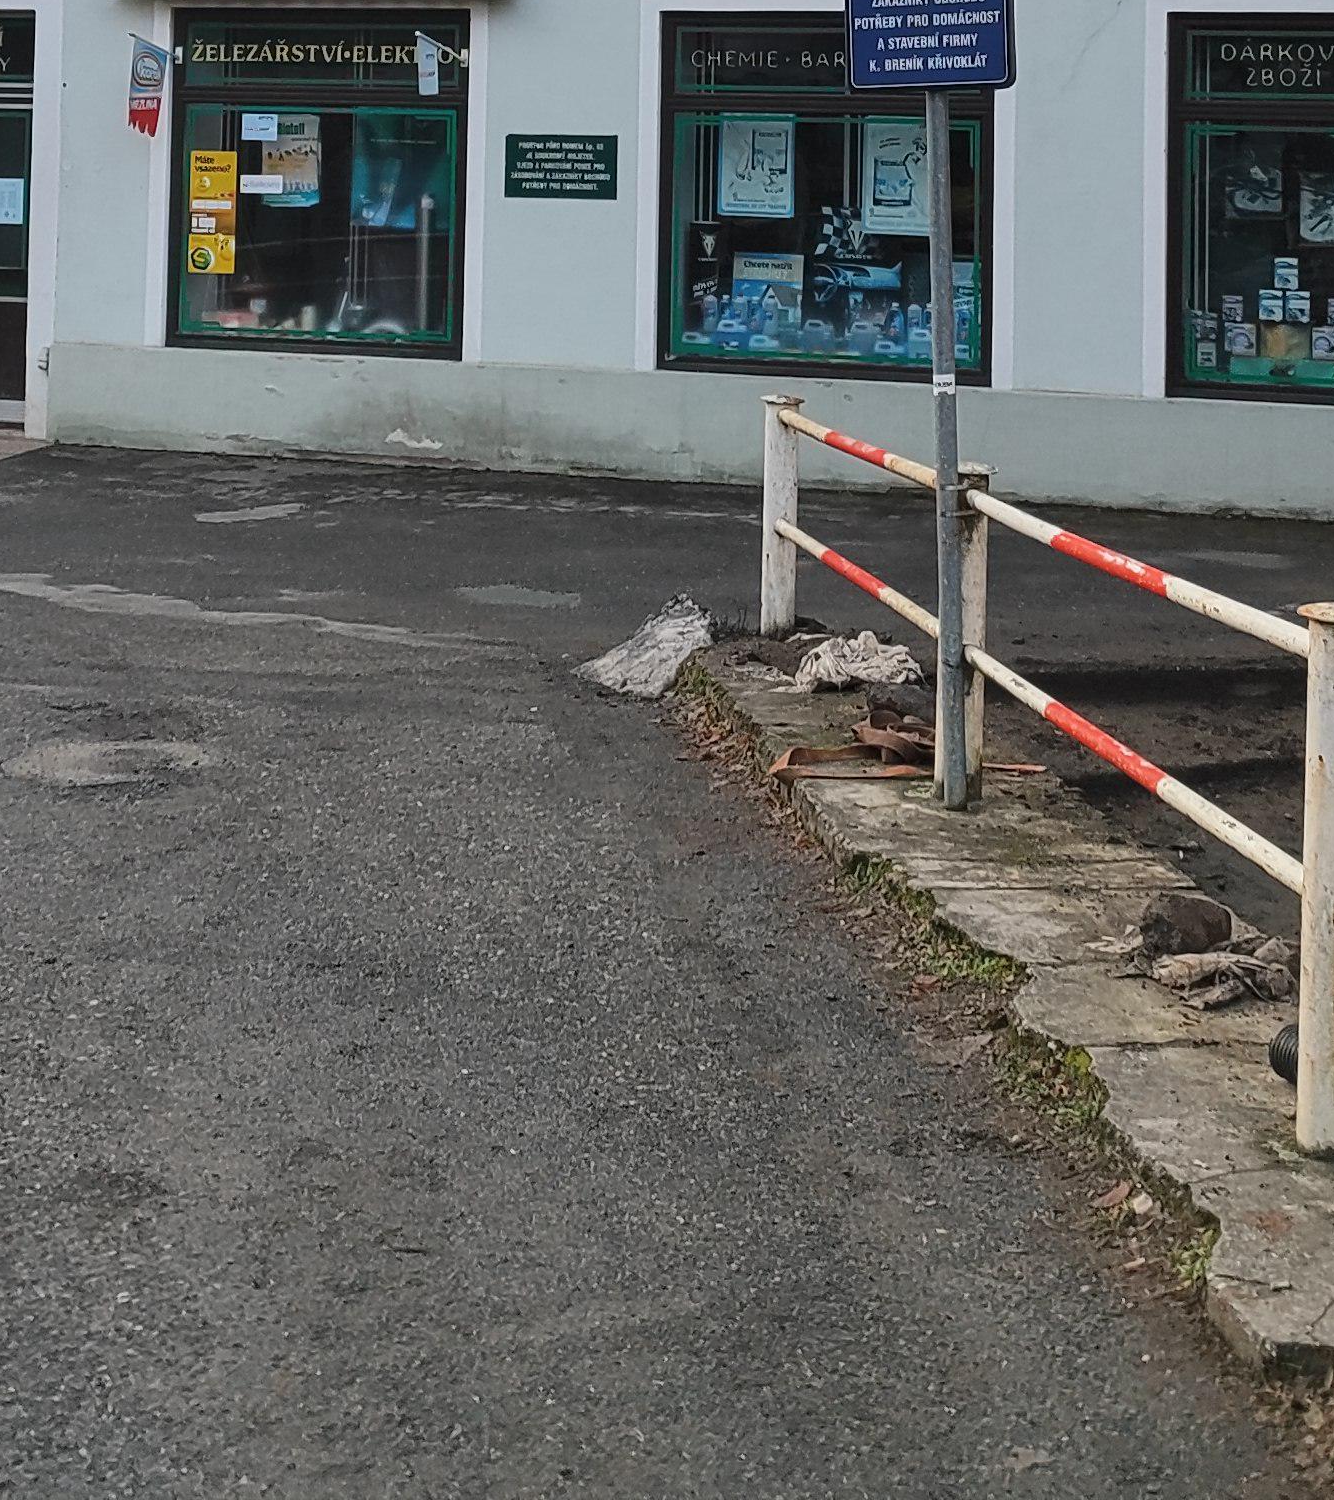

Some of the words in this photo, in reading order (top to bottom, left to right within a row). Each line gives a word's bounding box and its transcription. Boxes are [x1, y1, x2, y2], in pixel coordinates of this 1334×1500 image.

[854, 13, 903, 30] POTŘEBY
[907, 15, 929, 28] PRO
[933, 8, 1001, 27] DOMÁCNOST
[191, 39, 343, 63] ŽELEZÁŘSTVÍ
[352, 45, 454, 65] ELEKTO
[877, 37, 885, 51] A
[888, 32, 939, 50] STAVEBNÍ
[942, 32, 978, 48] FIRMY
[691, 50, 778, 68] CHEMIE
[801, 51, 847, 68] BAR
[869, 59, 881, 73] K.
[885, 53, 924, 72] BRENÍK
[928, 51, 988, 70] KŘIVOKLÁT
[1245, 63, 1322, 87] ZBOŽÍ
